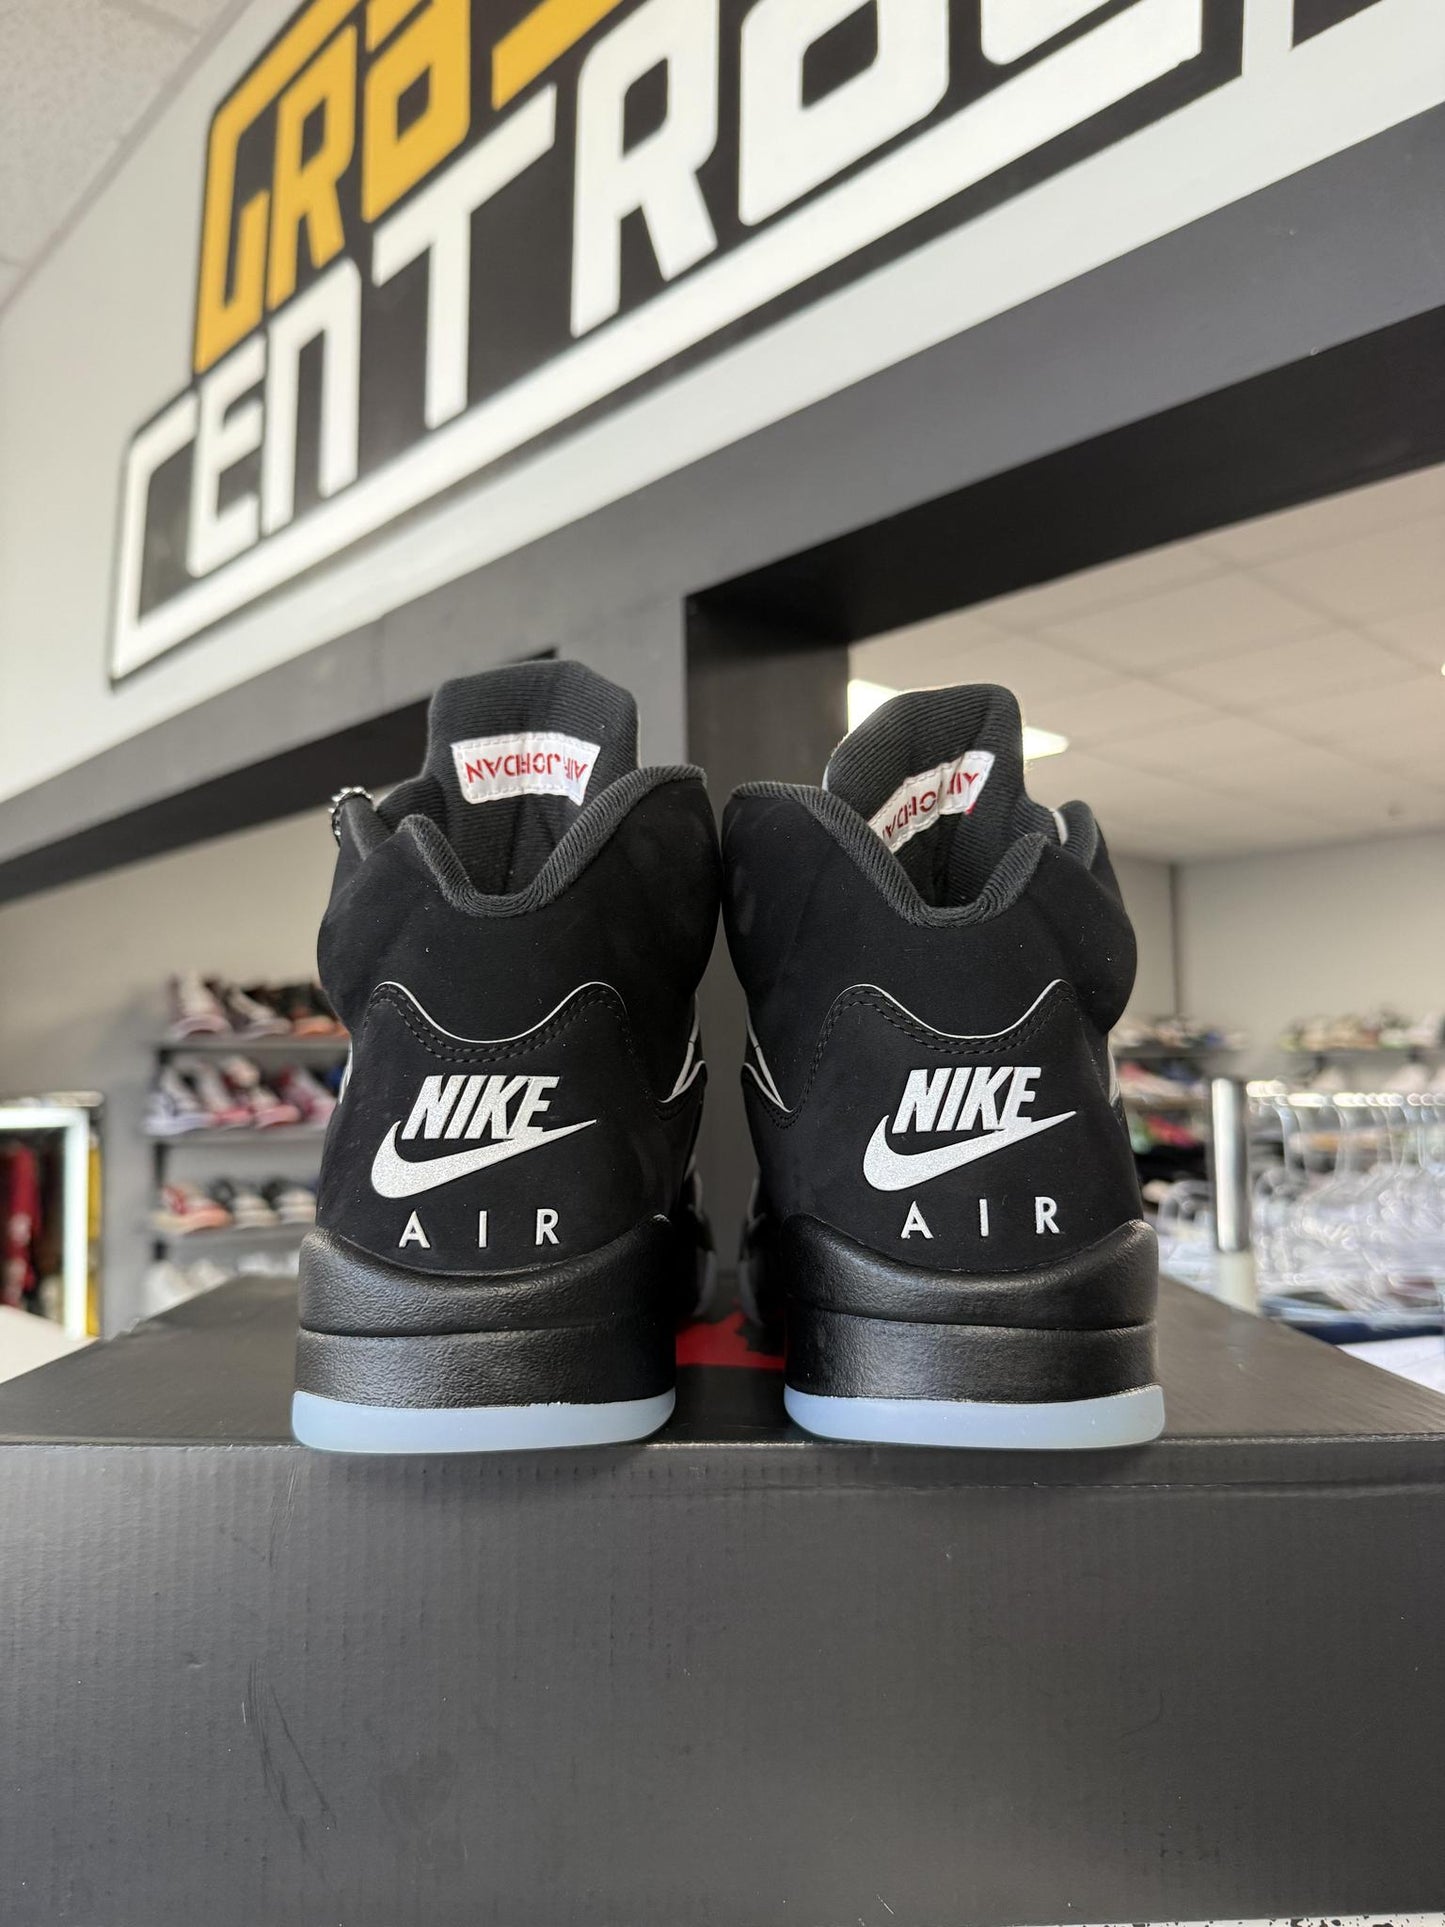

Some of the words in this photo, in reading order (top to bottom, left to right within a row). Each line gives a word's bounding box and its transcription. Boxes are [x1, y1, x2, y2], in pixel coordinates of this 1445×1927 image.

[465, 753, 560, 783] JORDAN
[401, 1074, 560, 1140] NIKE
[891, 1066, 1042, 1132] NIKE
[398, 1208, 561, 1249] AIR
[900, 1196, 1061, 1239] AIR
